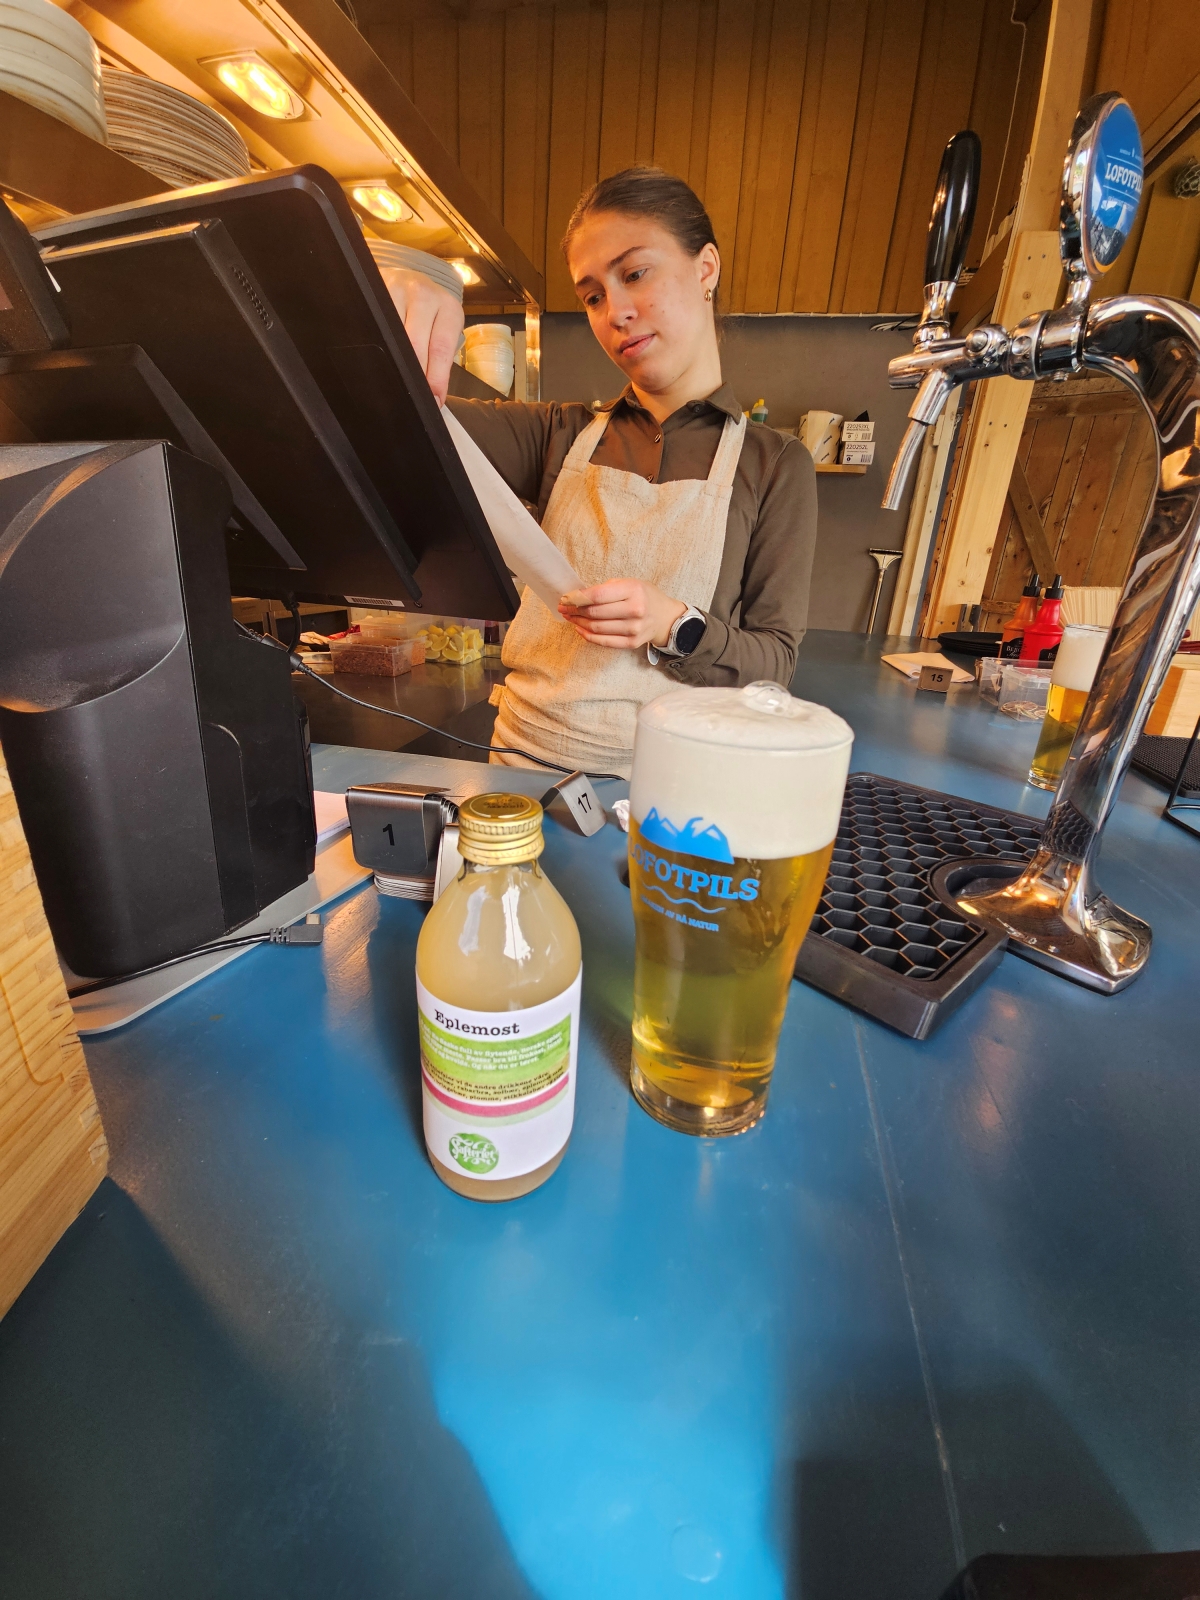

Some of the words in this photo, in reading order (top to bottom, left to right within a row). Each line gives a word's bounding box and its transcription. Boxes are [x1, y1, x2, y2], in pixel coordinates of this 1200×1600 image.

[931, 673, 944, 683] 15
[577, 792, 593, 814] 17
[382, 823, 396, 847] 1
[688, 917, 719, 932] NATUR
[434, 1008, 520, 1036] Eplemost
